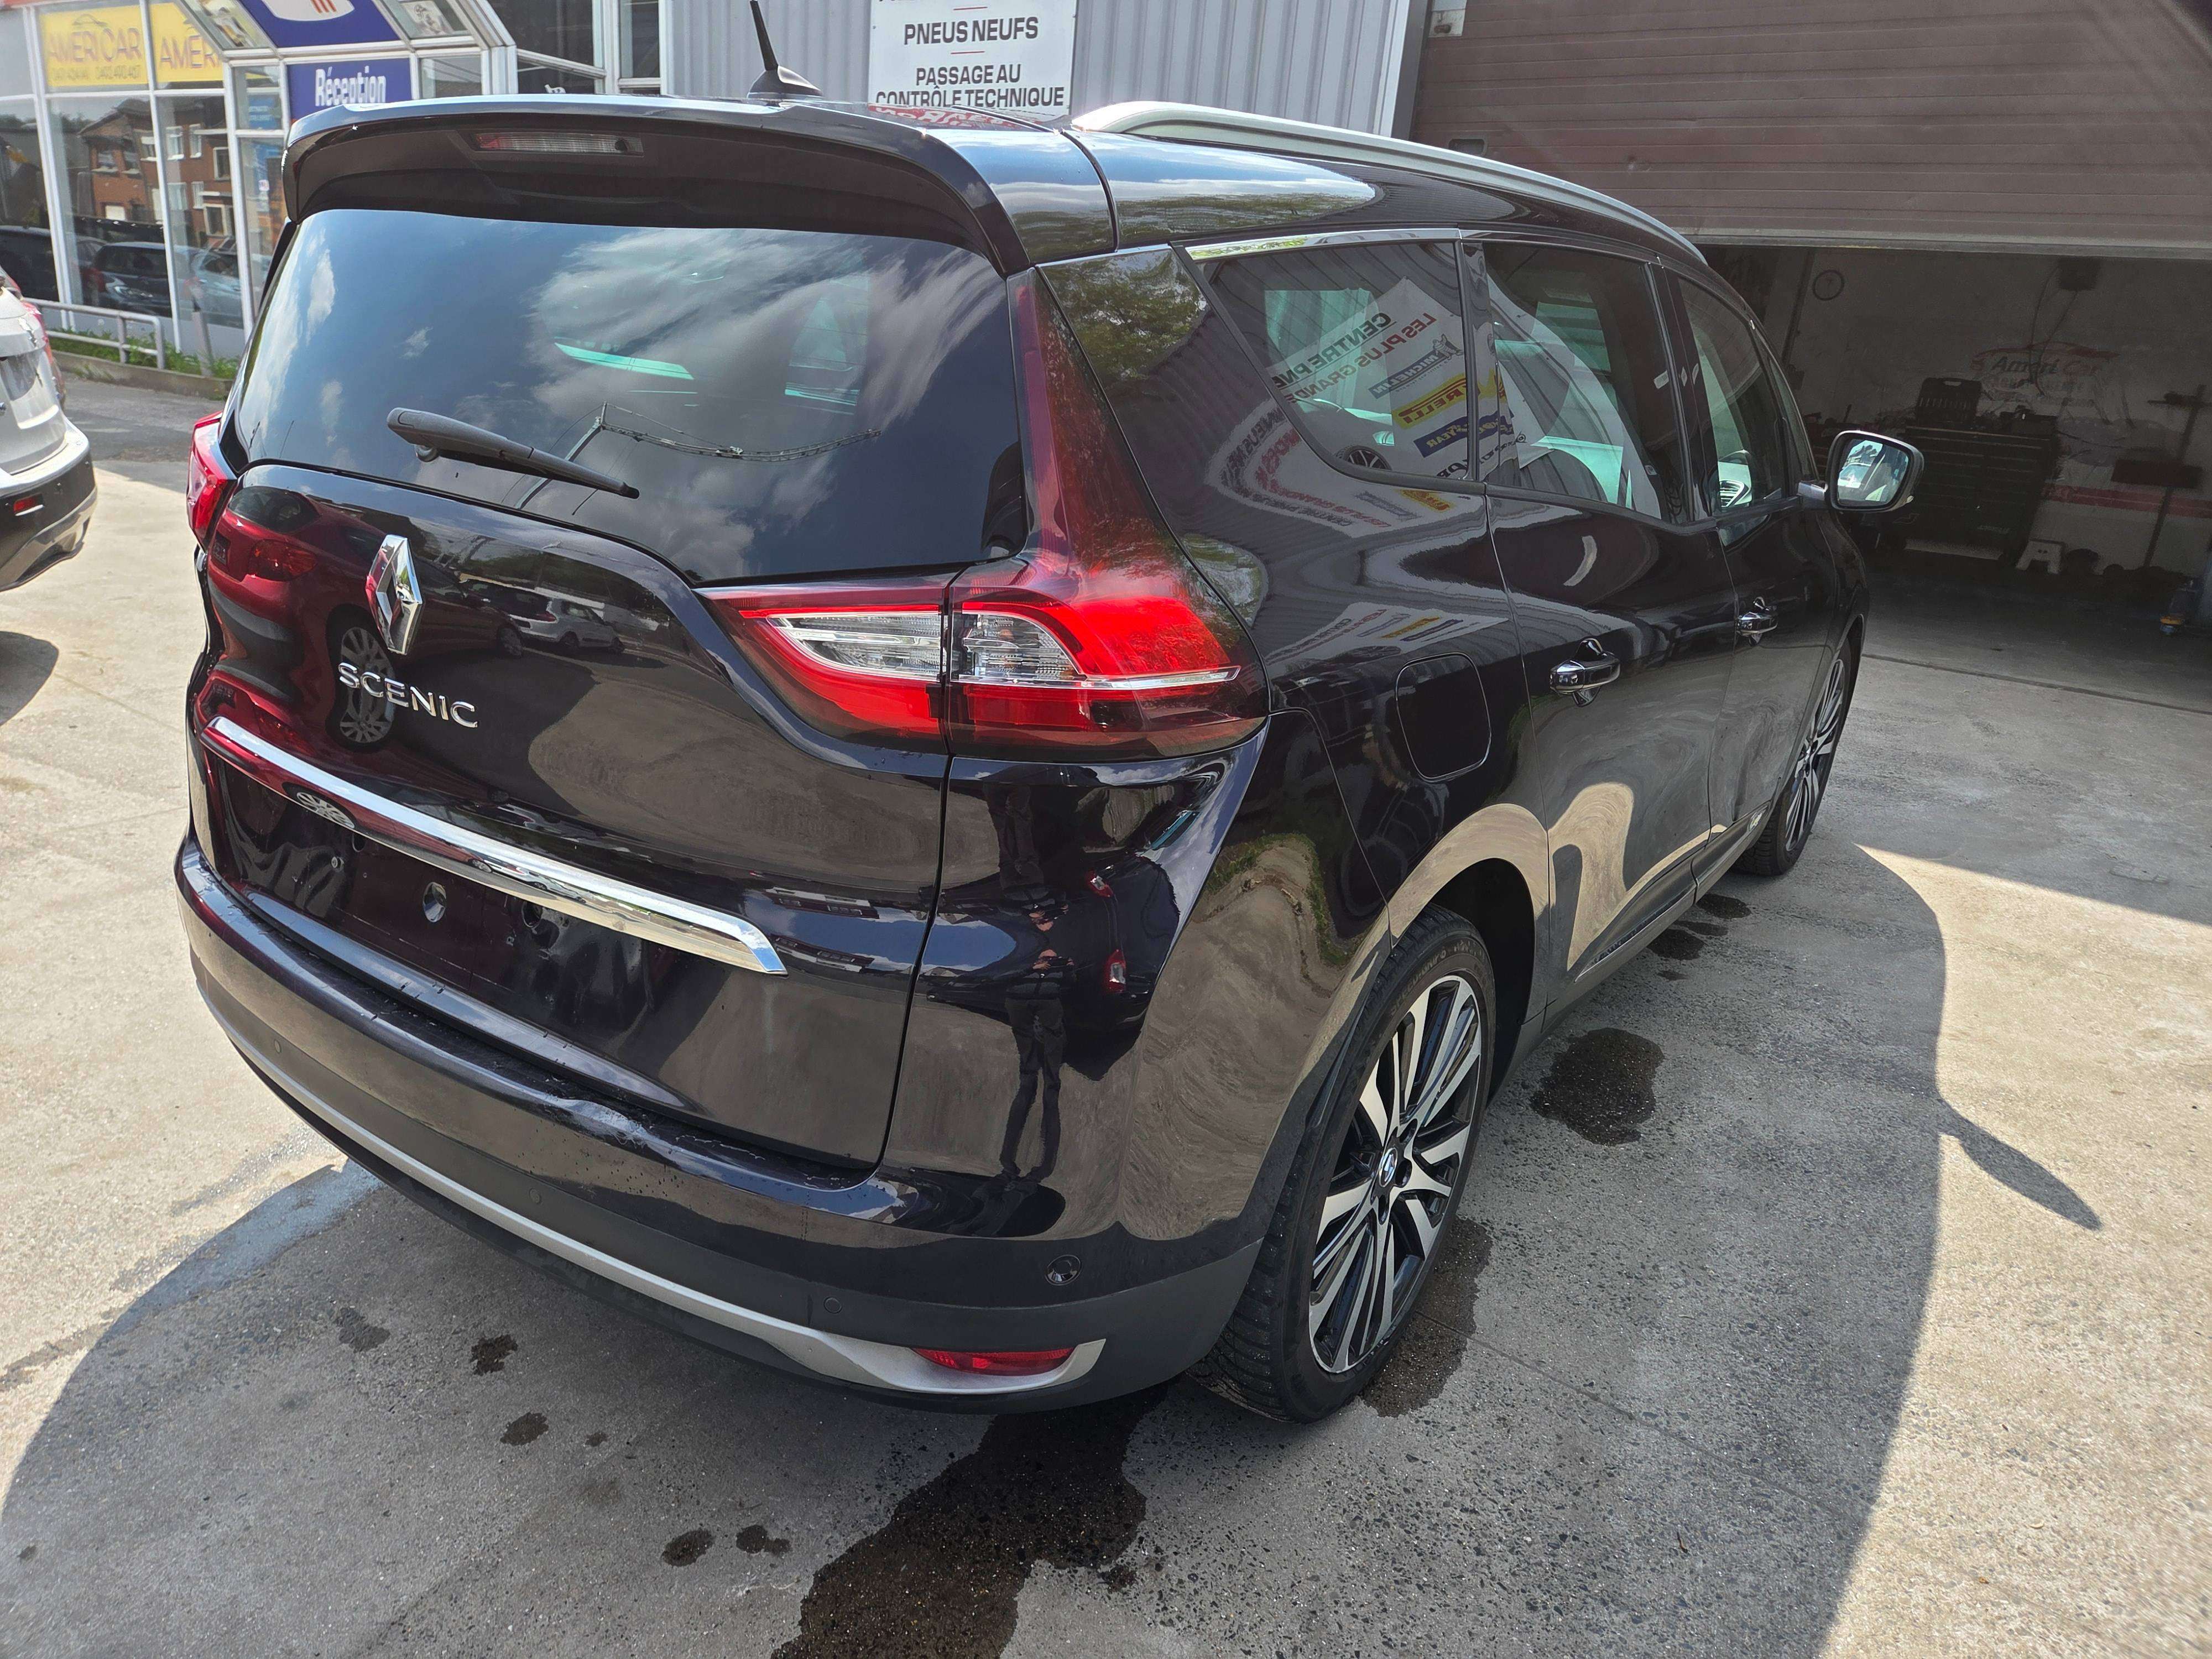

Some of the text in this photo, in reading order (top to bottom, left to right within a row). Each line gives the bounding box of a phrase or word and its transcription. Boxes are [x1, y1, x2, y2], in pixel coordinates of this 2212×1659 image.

[904, 17, 1039, 45] PNEUS NEUFS
[160, 30, 220, 69] AMER
[315, 65, 387, 106] Réception
[916, 64, 1021, 86] PASSAGE AU
[876, 85, 1065, 107] CONTRÔLE TECHNIQUE
[337, 661, 479, 729] SCENIC
